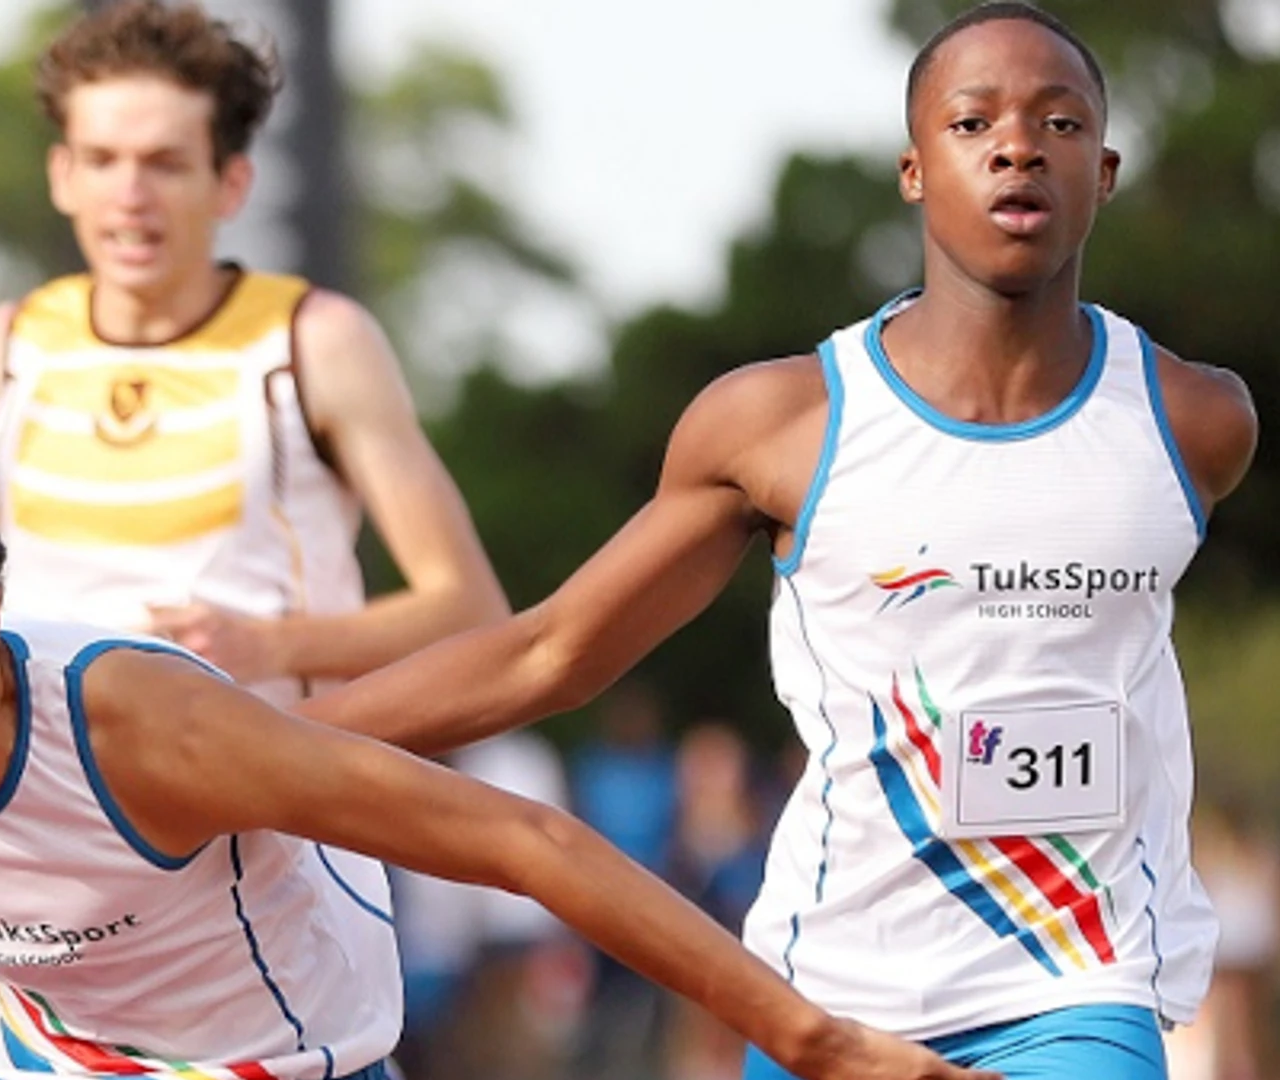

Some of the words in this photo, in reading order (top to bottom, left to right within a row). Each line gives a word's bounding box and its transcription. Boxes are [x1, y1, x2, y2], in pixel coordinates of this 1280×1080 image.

[971, 561, 1160, 598] TuksSport
[979, 604, 1022, 618] HIGH
[1027, 604, 1093, 618] SCHOOL
[1006, 742, 1092, 790] 311
